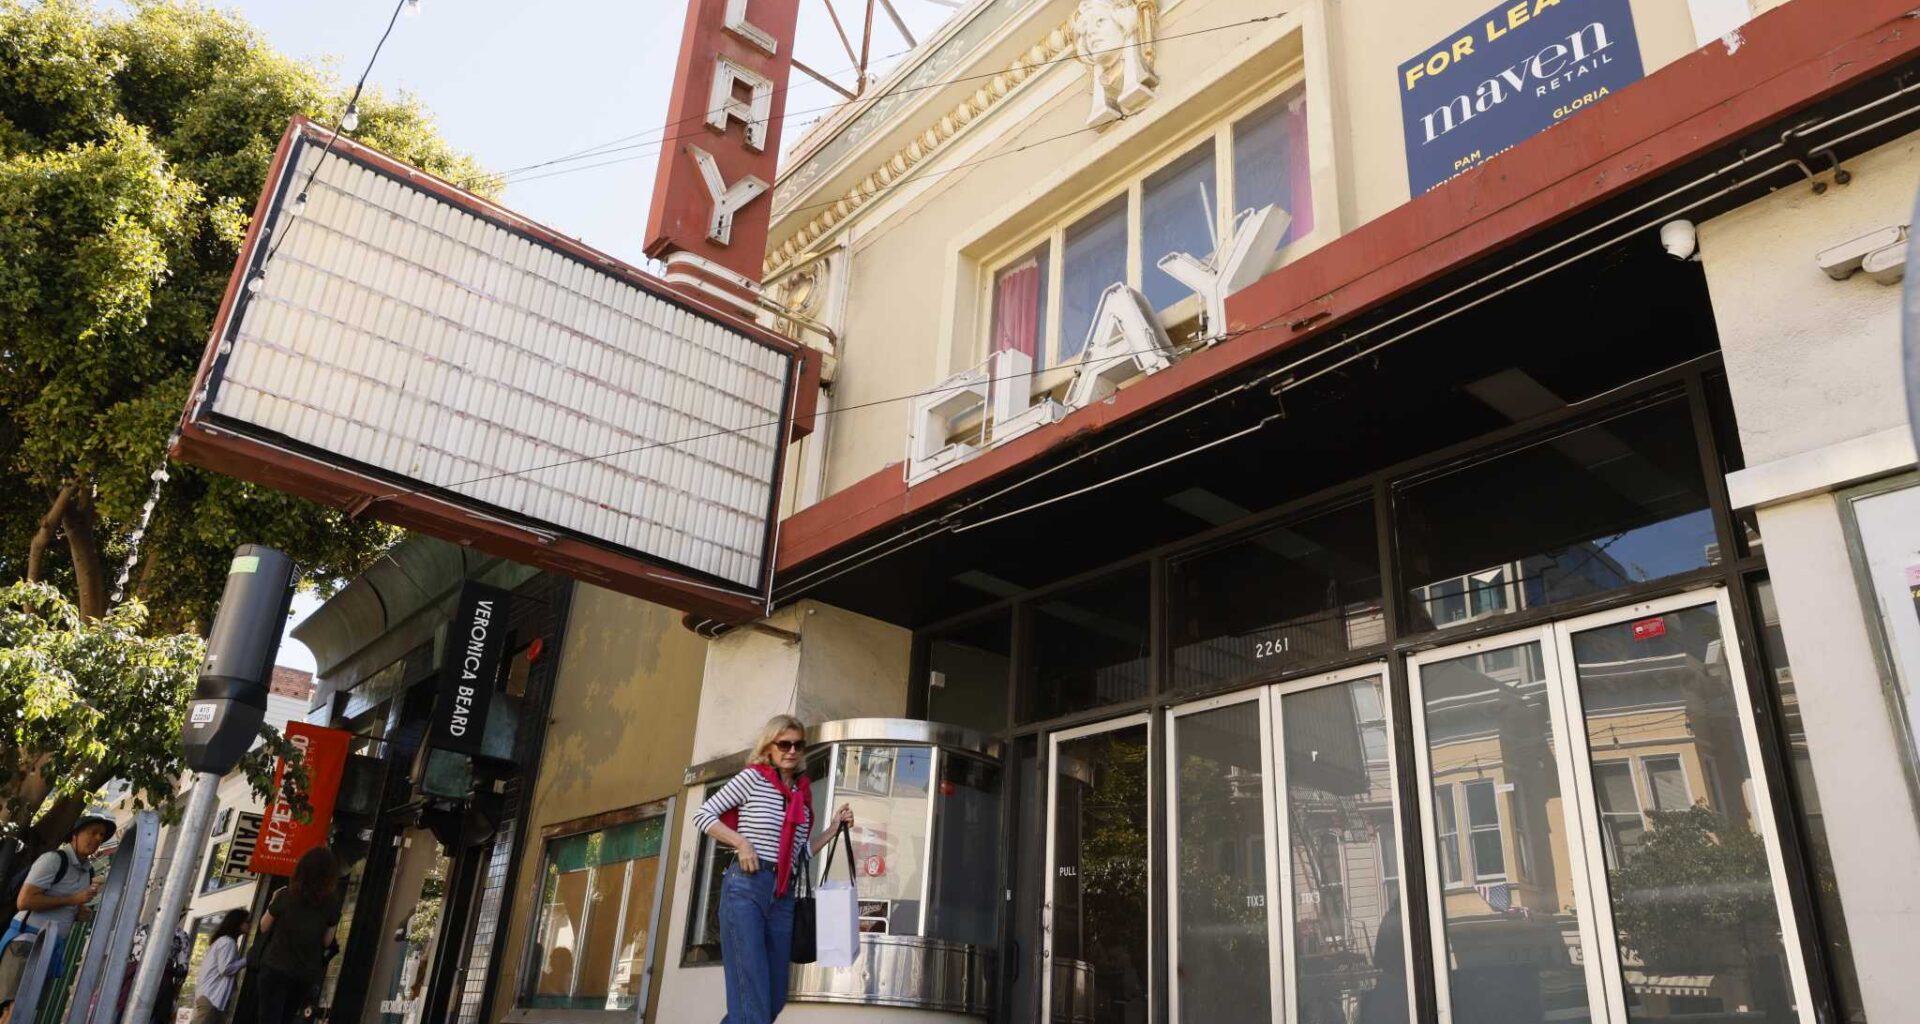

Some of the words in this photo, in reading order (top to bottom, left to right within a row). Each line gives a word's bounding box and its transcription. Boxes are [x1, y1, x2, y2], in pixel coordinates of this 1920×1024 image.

[1405, 35, 1475, 91] FOR
[1419, 21, 1614, 146] maven
[1536, 54, 1613, 98] RETAIL
[1552, 86, 1609, 119] GLORIA
[1454, 150, 1481, 170] PAM
[904, 203, 1291, 488] CLAY
[462, 600, 493, 680] VERONICA
[1255, 637, 1289, 658] 2261
[450, 685, 474, 737] BEARD
[1059, 866, 1077, 877] PULL
